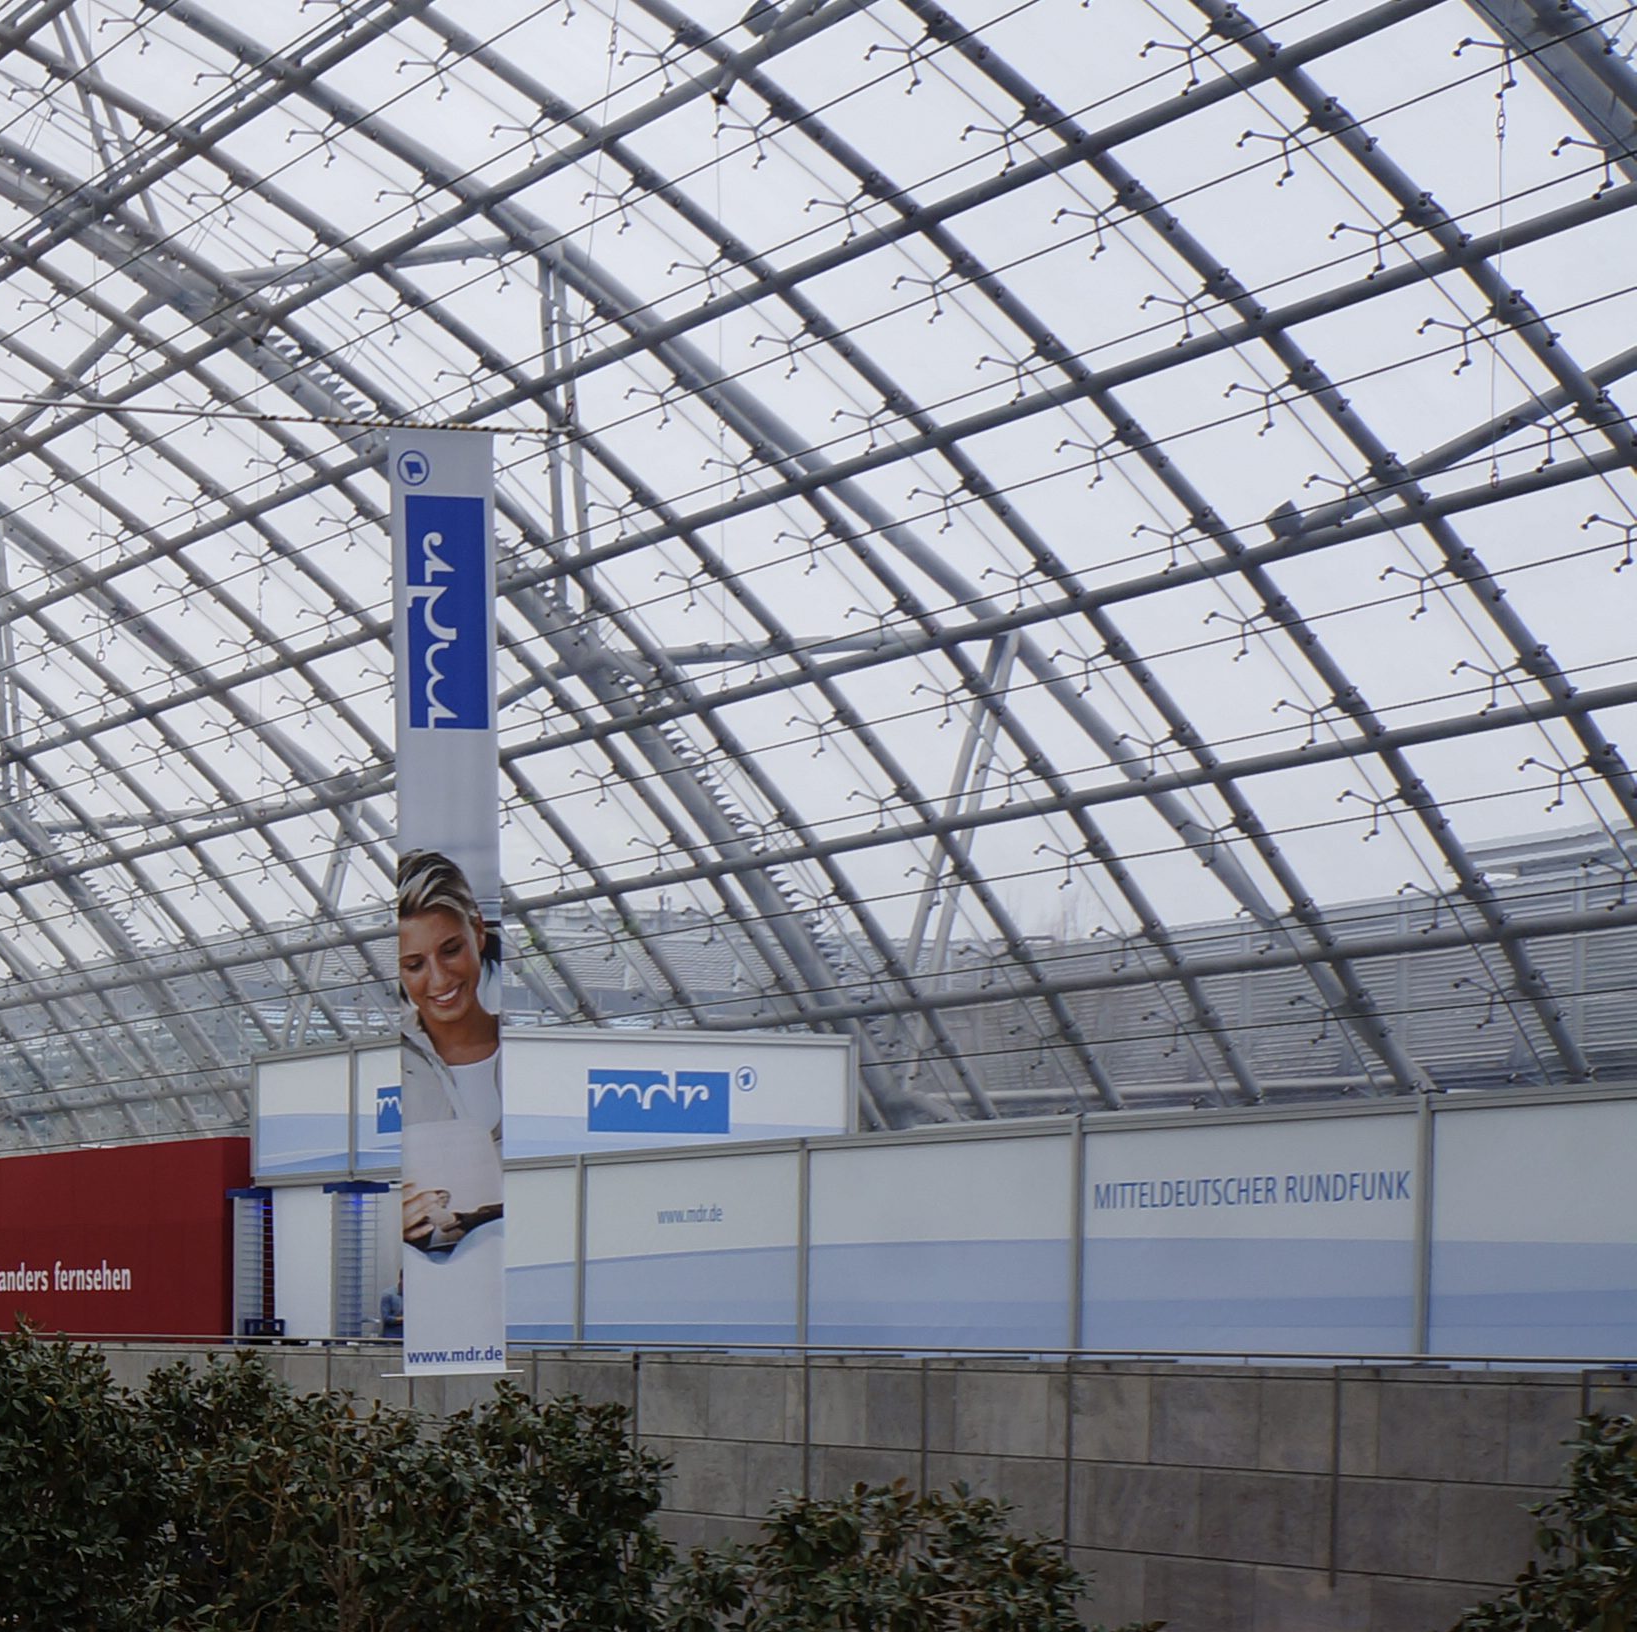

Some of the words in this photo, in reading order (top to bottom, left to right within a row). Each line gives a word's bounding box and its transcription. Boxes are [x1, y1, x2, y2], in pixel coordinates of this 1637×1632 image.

[587, 1069, 710, 1111] mdr
[1093, 1175, 1278, 1210] MITTELDEUTSCHER
[1285, 1170, 1413, 1204] RUNDFUNK
[656, 1205, 723, 1225] www.mdr.de
[53, 1260, 132, 1293] fernsehen
[407, 1345, 503, 1364] www.mdr.de
